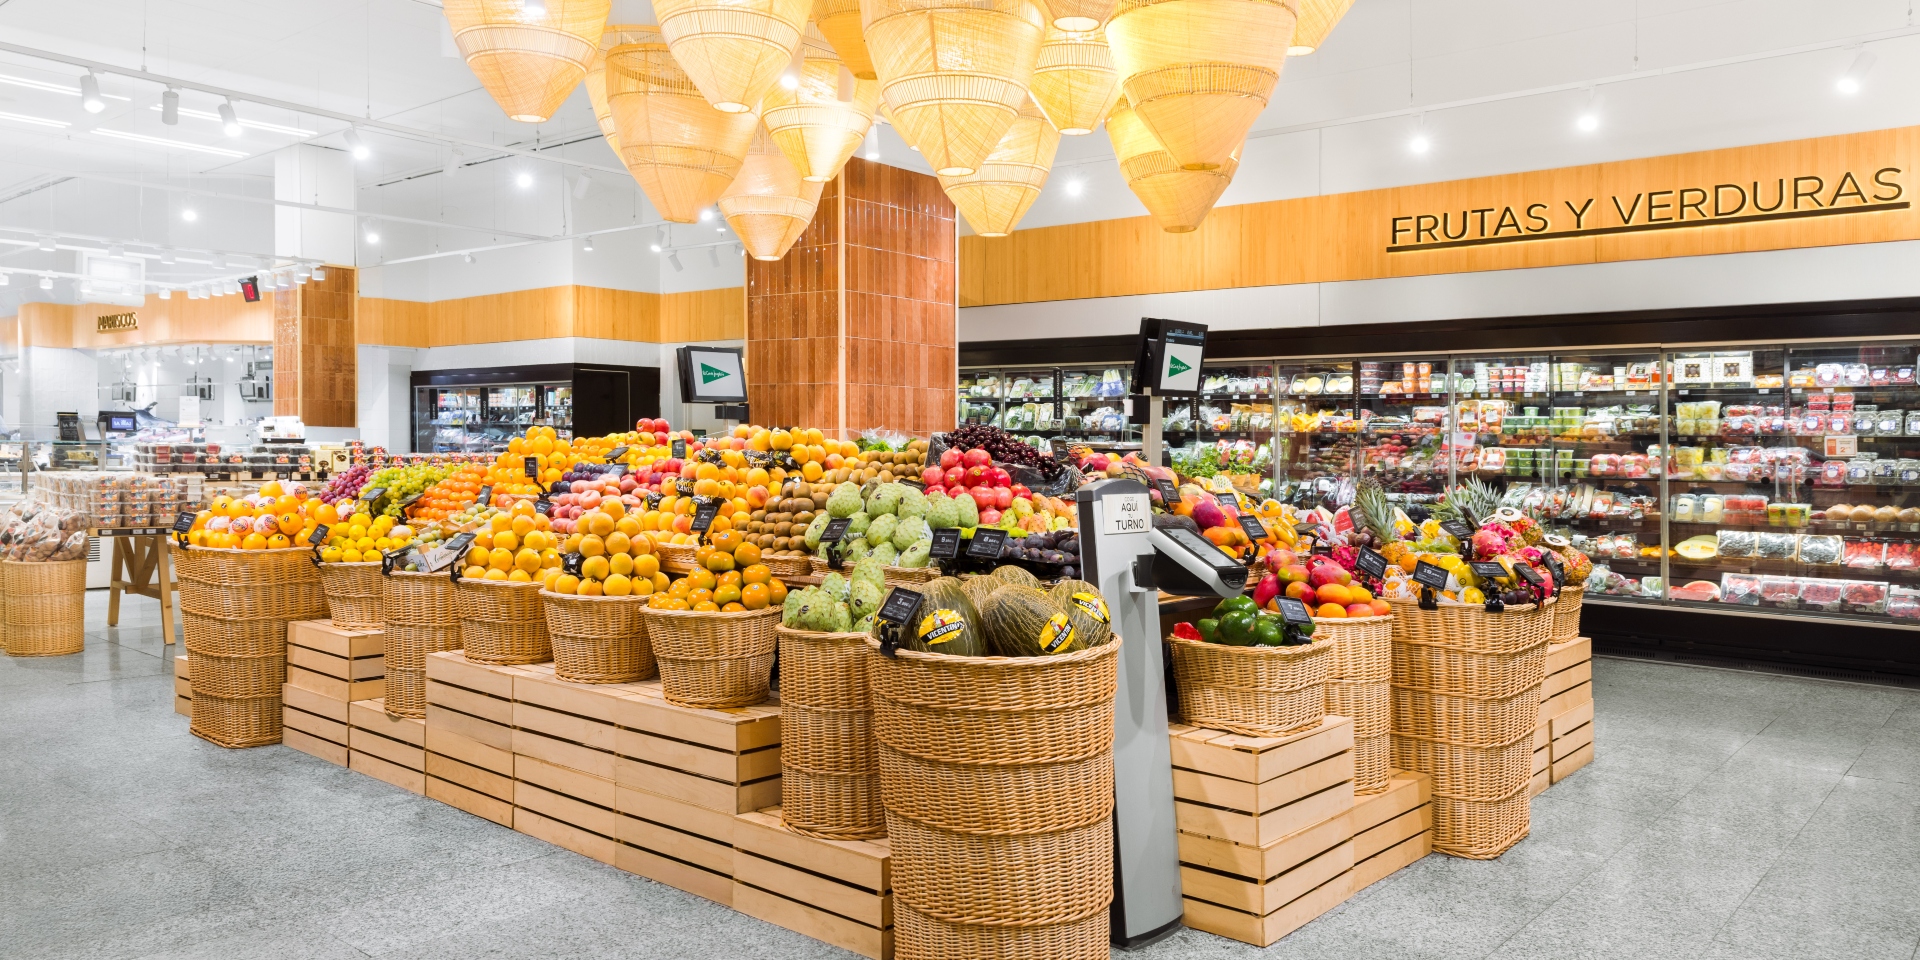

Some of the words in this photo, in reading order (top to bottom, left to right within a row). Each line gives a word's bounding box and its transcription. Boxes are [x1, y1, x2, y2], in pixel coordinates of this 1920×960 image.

[1390, 203, 1549, 245] FRUTAS
[1564, 198, 1595, 230] Y
[1611, 167, 1904, 225] VERDURAS
[97, 311, 138, 330] MARISCOS
[1121, 500, 1139, 513] AQUÍ
[1115, 518, 1145, 531] TURNO
